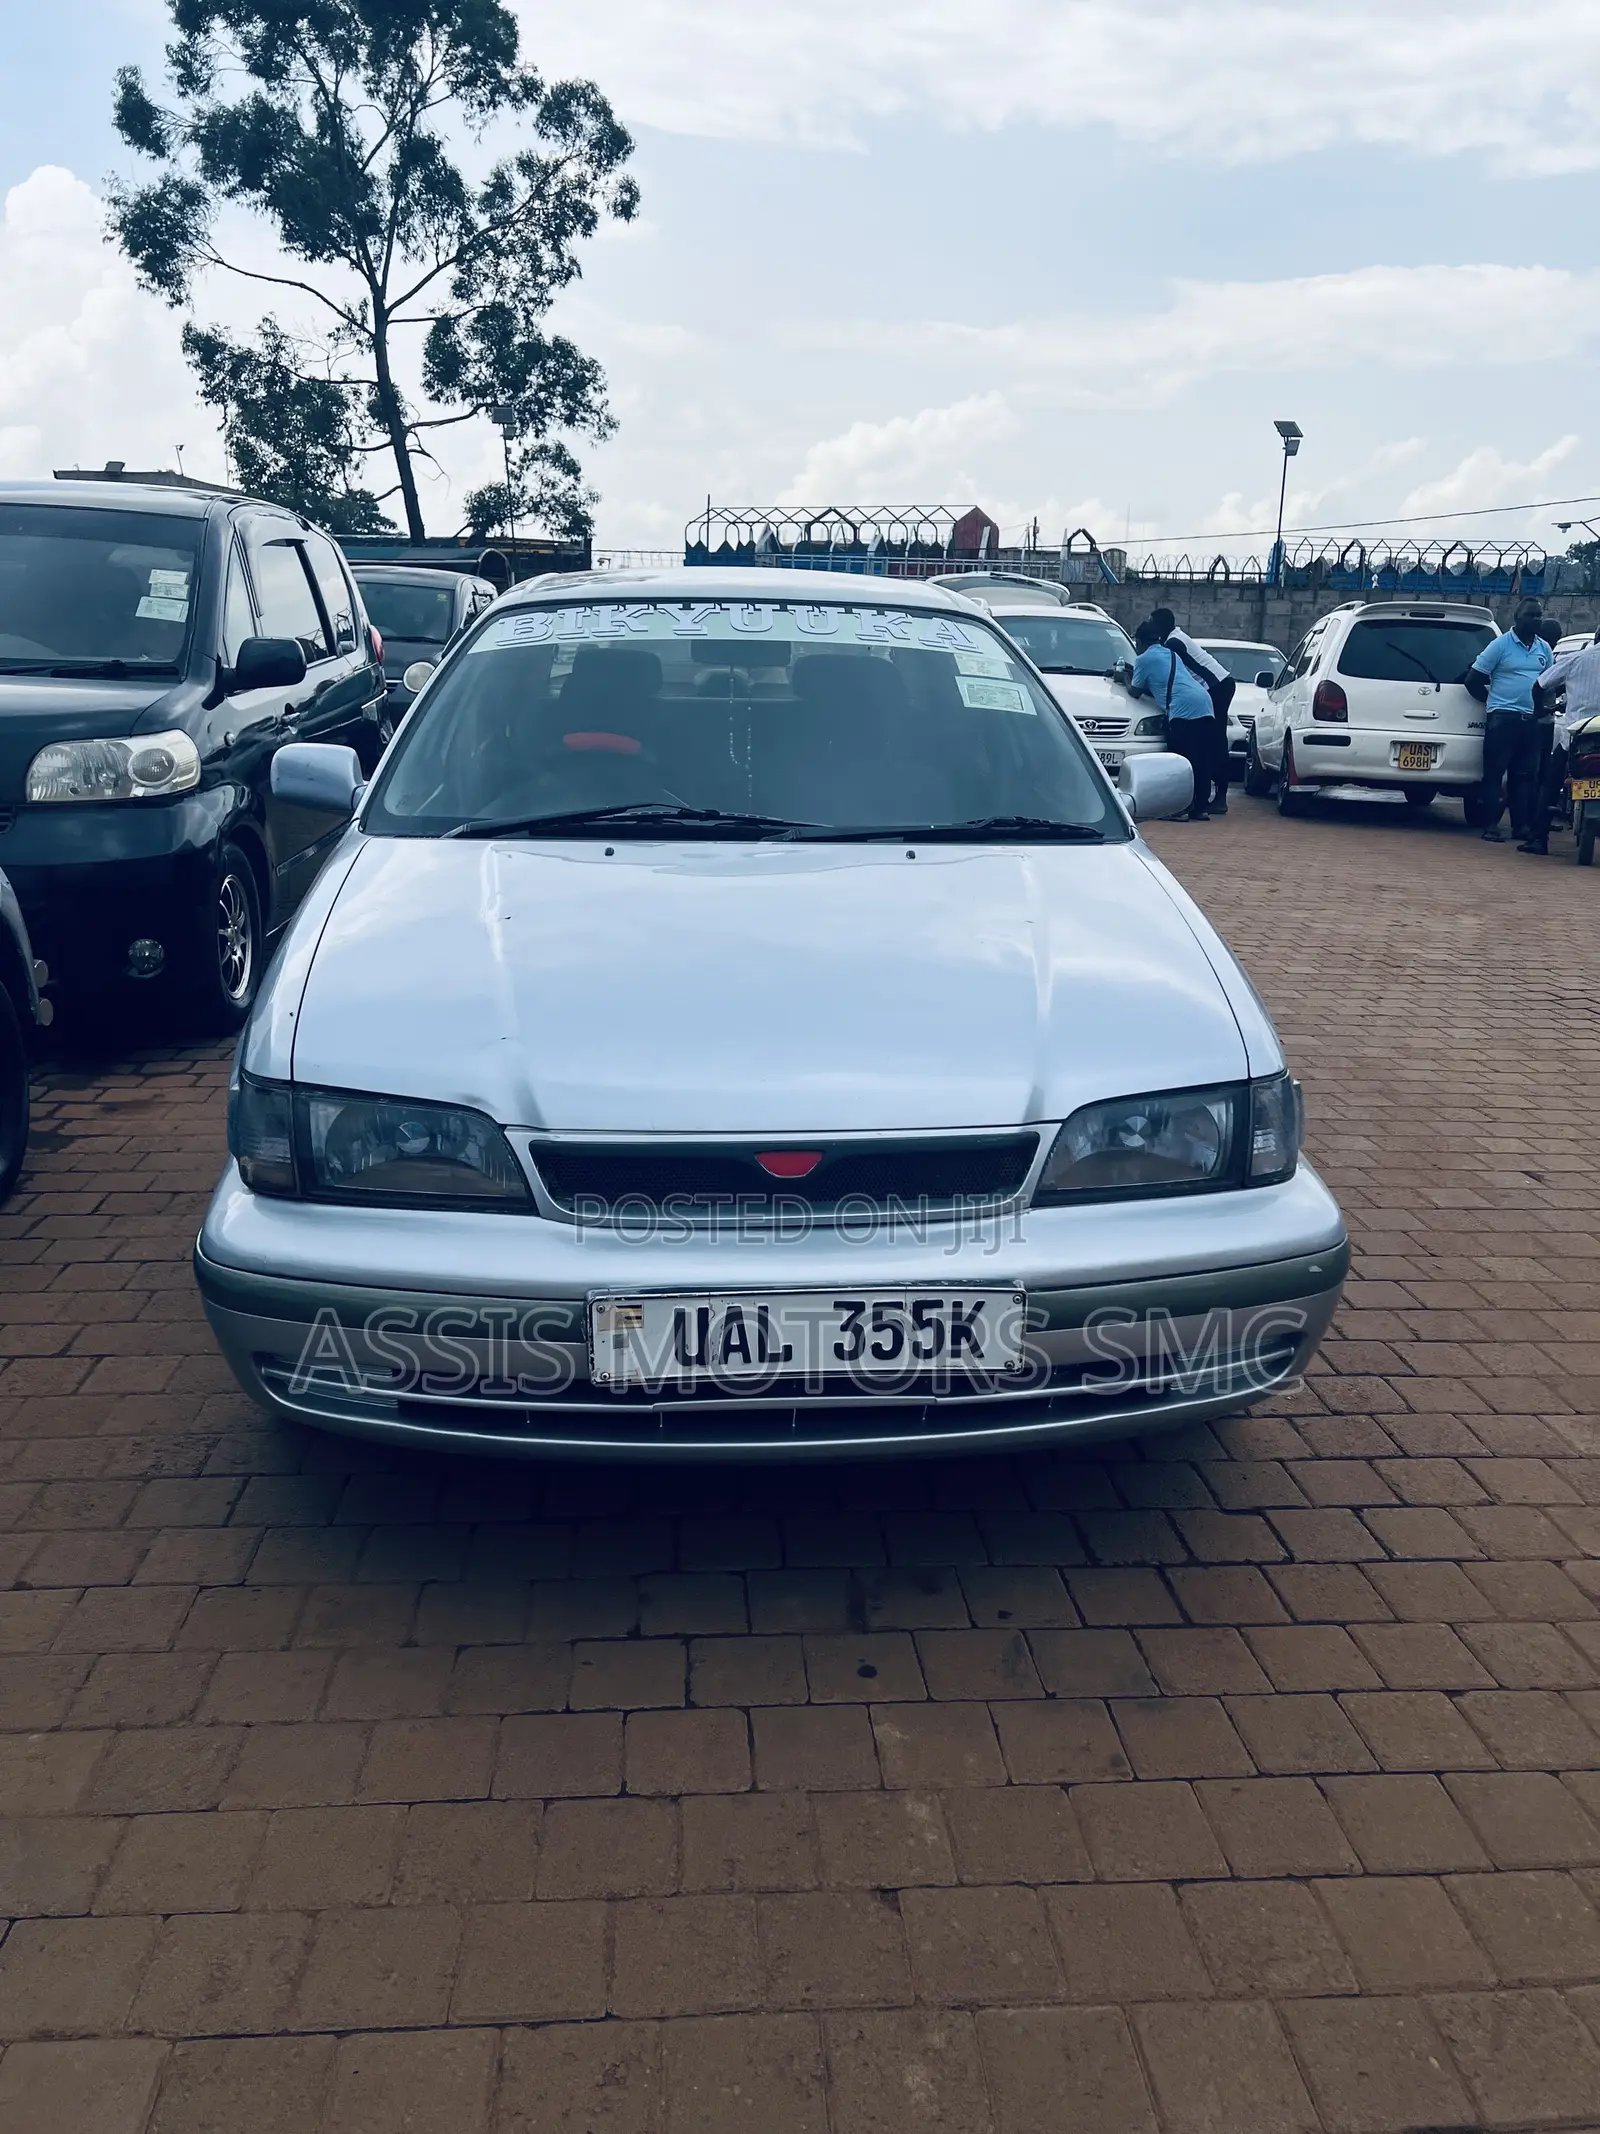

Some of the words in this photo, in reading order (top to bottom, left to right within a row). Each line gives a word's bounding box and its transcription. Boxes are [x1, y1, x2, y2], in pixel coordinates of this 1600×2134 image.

[495, 603, 983, 655] BIKYUUKA
[1409, 744, 1431, 756] UAS
[1096, 752, 1118, 764] 89L
[1402, 756, 1429, 768] 698H
[673, 1304, 793, 1367] UAL
[832, 1299, 987, 1361] 355K
